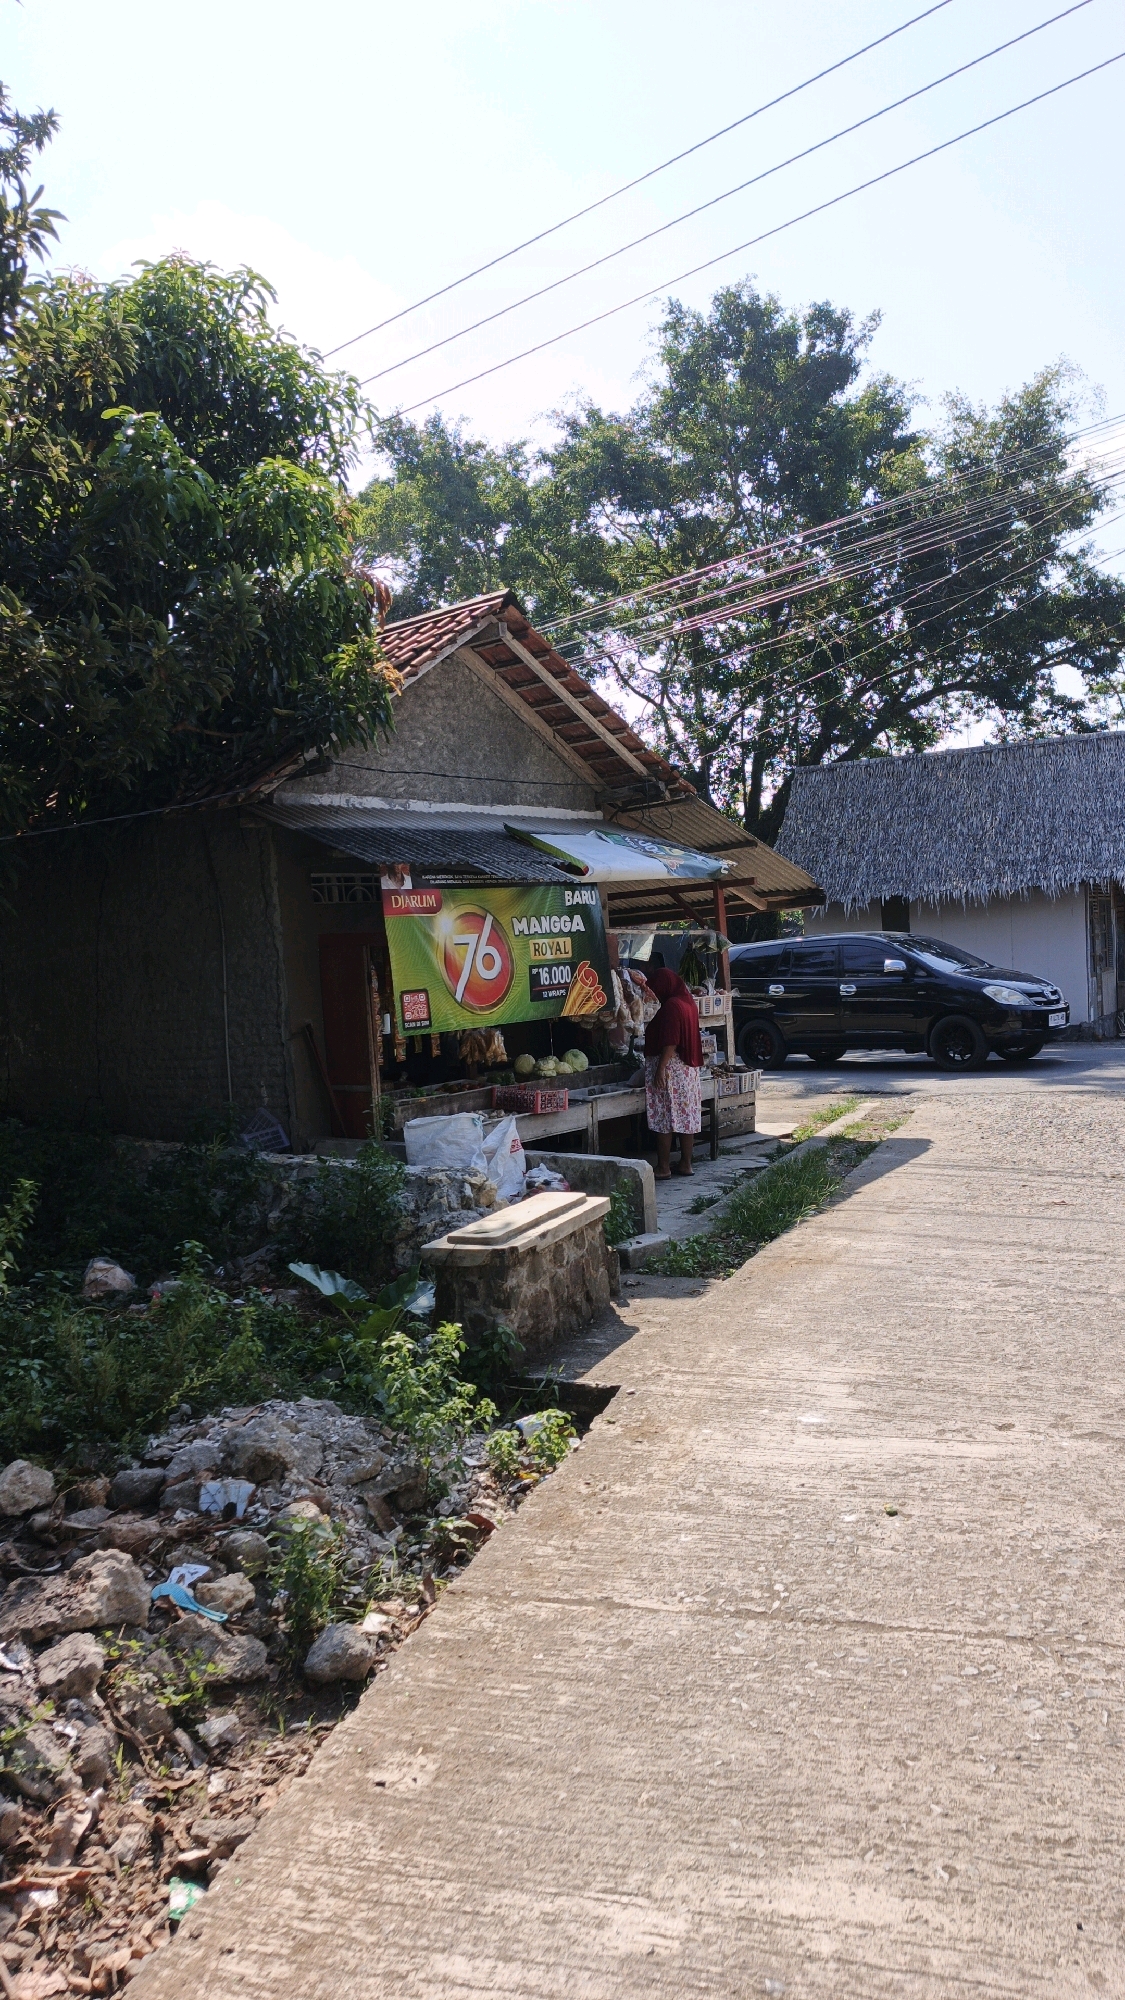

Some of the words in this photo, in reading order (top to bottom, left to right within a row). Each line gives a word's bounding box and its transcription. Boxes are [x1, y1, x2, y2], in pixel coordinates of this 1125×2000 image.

[391, 894, 437, 909] DJARUM
[564, 890, 596, 906] BARU
[511, 914, 586, 936] MANGGA
[452, 912, 502, 1003] 76
[532, 940, 570, 957] ROYAL
[539, 965, 571, 985] 16.000
